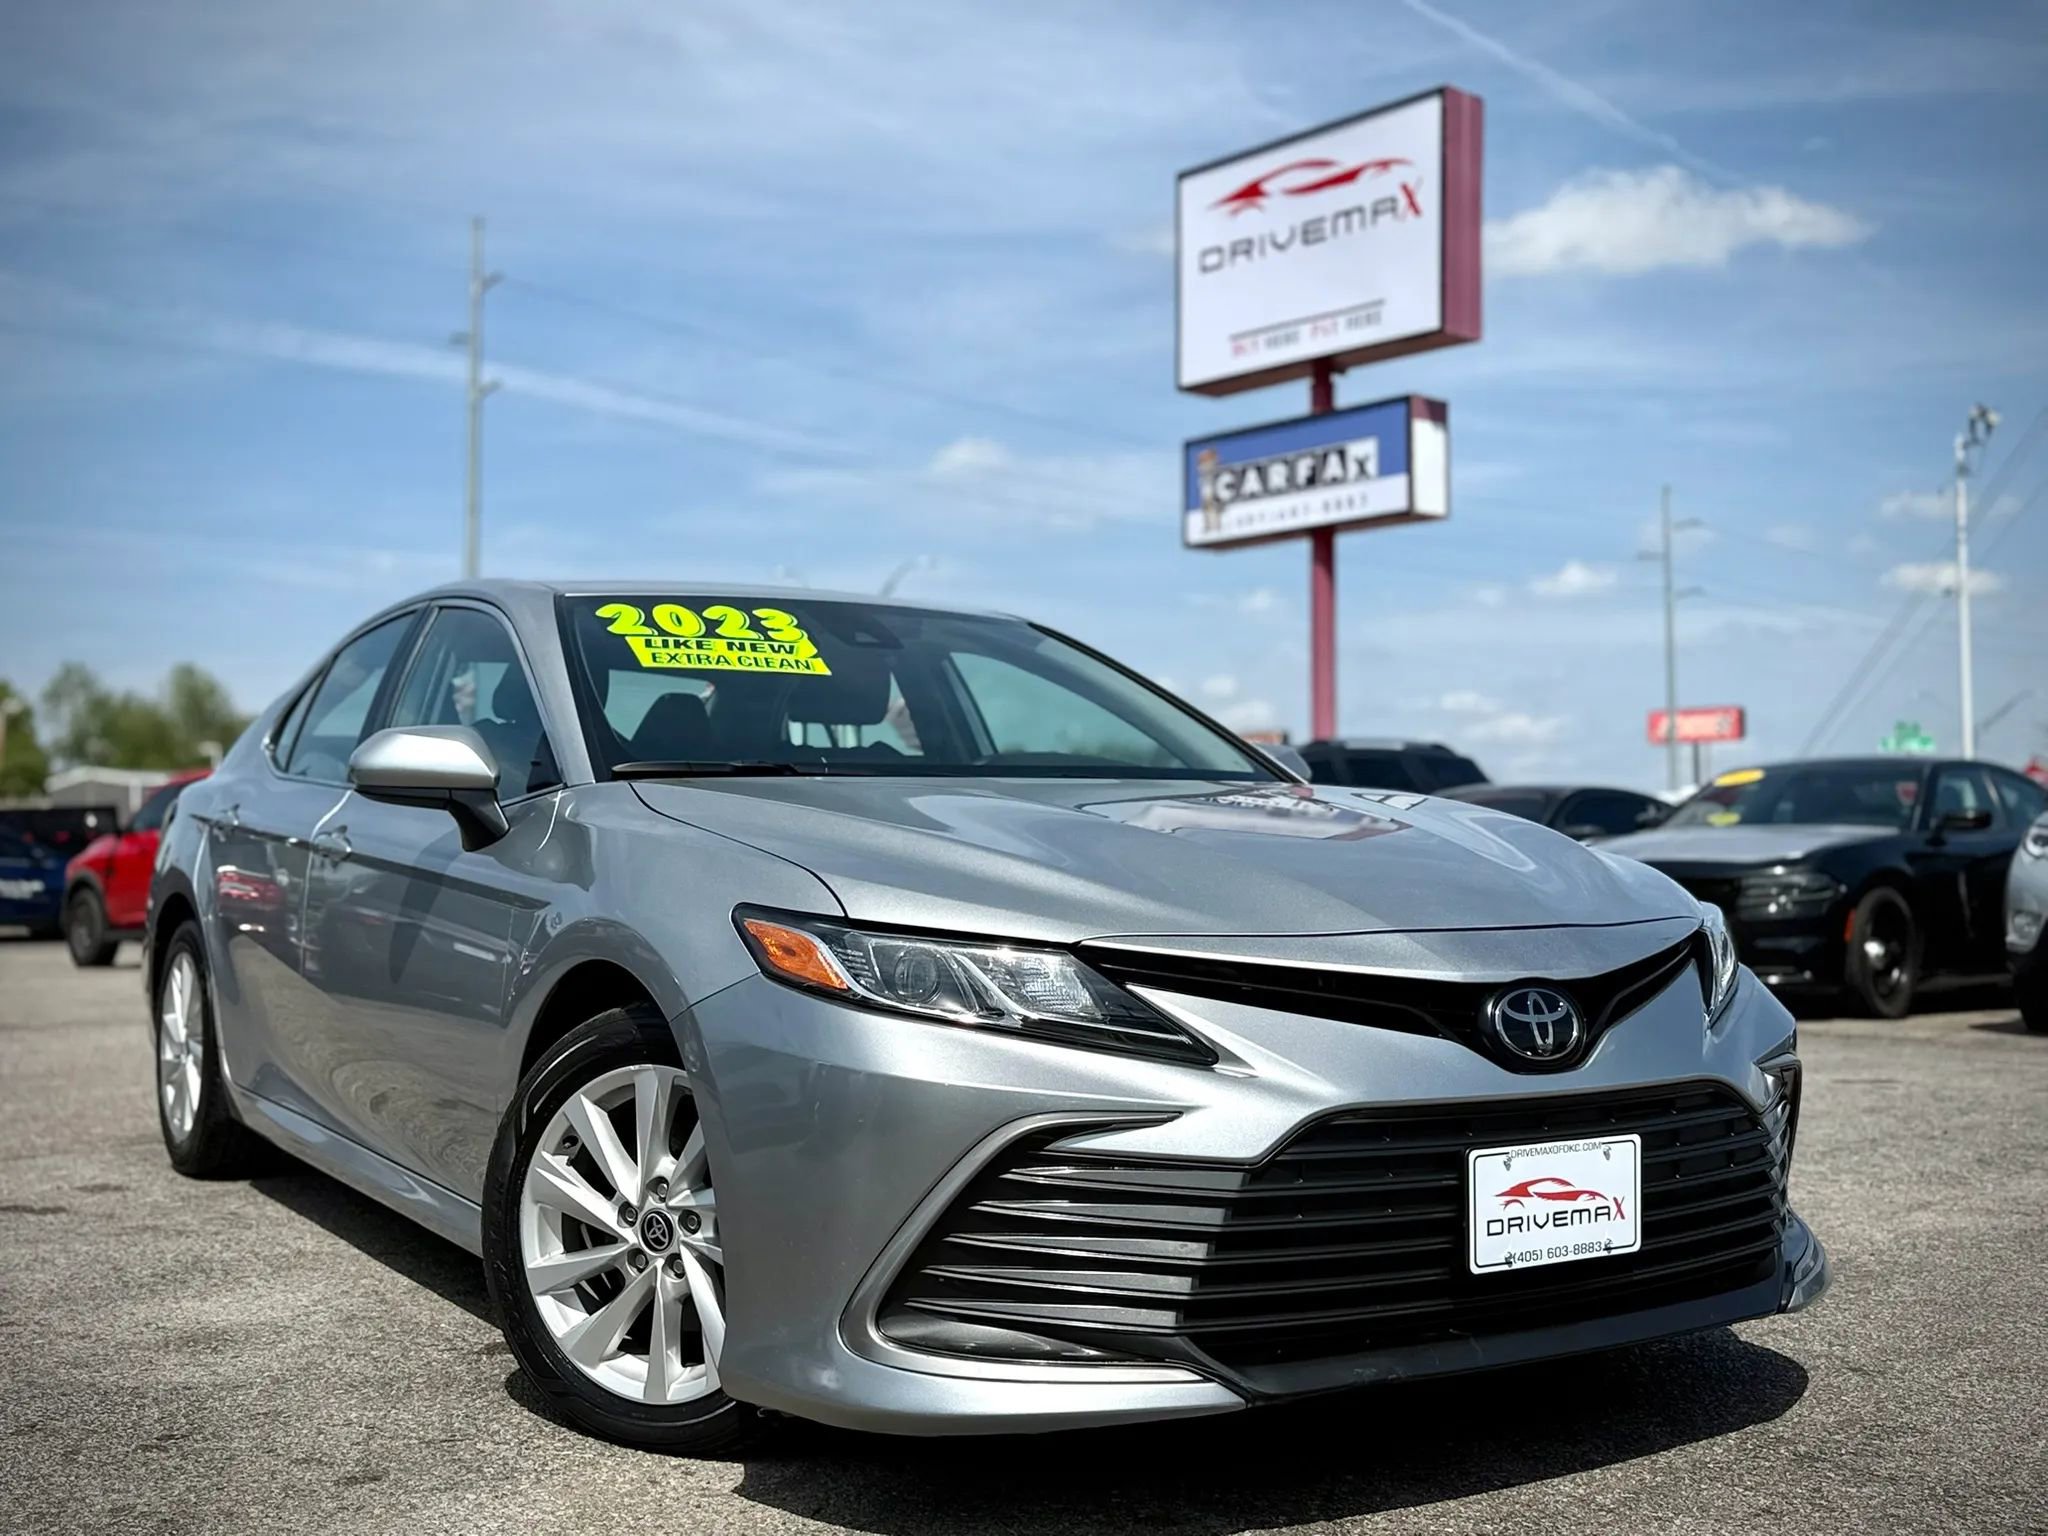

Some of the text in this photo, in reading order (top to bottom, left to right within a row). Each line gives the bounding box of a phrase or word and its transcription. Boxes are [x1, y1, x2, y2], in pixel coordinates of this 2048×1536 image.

[1199, 180, 1421, 274] DRIVEMAX
[1215, 448, 1371, 502] CARFAX
[595, 603, 808, 642] 2023
[644, 638, 796, 655] LIKE NEW
[652, 652, 812, 671] EXTRA CLEAN
[1487, 1196, 1626, 1237] DRIVEMAX
[1512, 1241, 1602, 1264] (405) 603-8883
